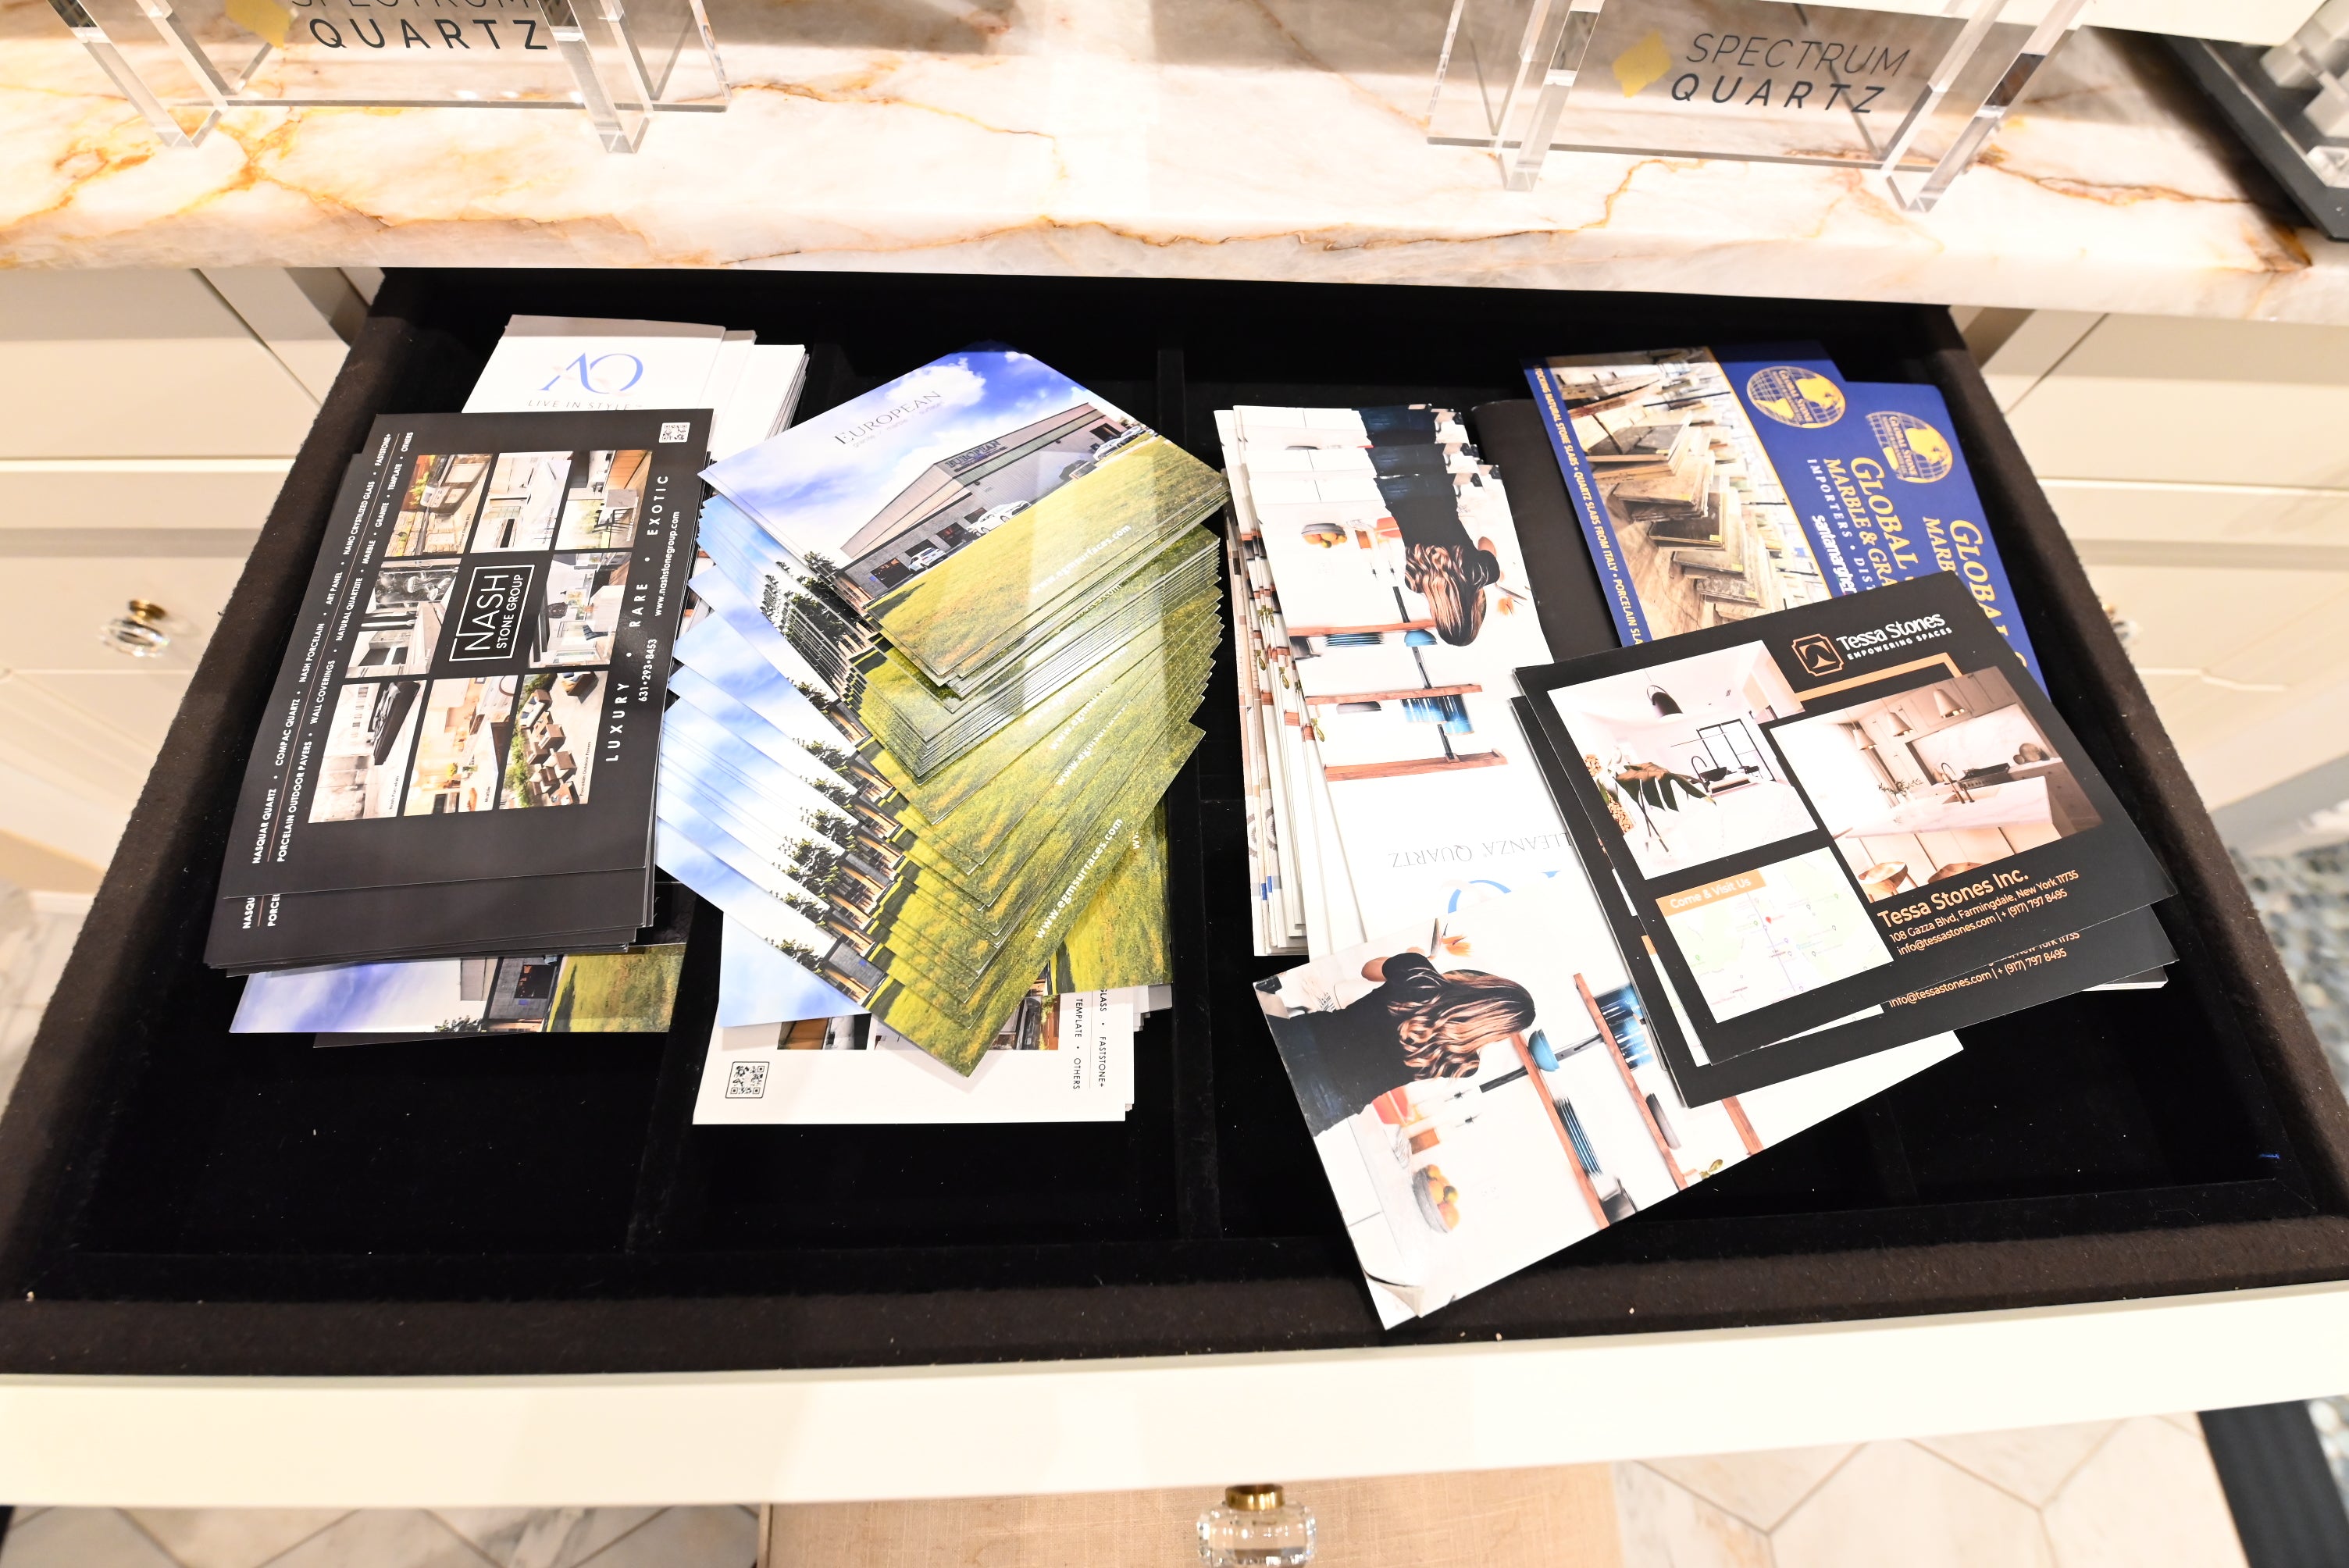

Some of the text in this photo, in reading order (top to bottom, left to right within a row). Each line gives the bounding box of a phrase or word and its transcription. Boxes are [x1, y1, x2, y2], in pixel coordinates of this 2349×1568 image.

[309, 18, 548, 50] QUARTZ
[1686, 33, 1910, 77] SPECTRUM
[1671, 73, 1886, 113] QUARTZ
[834, 390, 941, 444] EUROPEAN
[1545, 393, 1562, 422] NATURAL
[1556, 422, 1571, 444] STONE
[1564, 444, 1580, 467] SLABS
[1574, 471, 1592, 501] QUARTZ
[1585, 500, 1601, 526] SLABS
[1594, 526, 1610, 549] FROM
[1602, 549, 1619, 572] ITALY
[1613, 578, 1638, 626] PORCELAIN
[1807, 458, 1852, 538] IMPORTERS
[1823, 458, 1873, 529] MARBLE
[1859, 530, 1879, 546] &
[1850, 457, 1919, 570] GLOBAL
[654, 511, 680, 617] www.nashstonegroup.com
[1030, 524, 1132, 594] www.egmsurfaces.com
[1923, 516, 1959, 575] MARB
[456, 575, 509, 650] NASH
[496, 574, 524, 649] STONE GROUP
[605, 683, 629, 762] LUXURY
[629, 583, 648, 628] RARE
[647, 476, 668, 536] EXOTIC
[1835, 613, 1945, 651] Tessa Stones
[1846, 627, 1953, 661] EMPOWERING SPACES
[251, 821, 269, 864] NASQUAR
[262, 788, 277, 820] QUARTZ
[275, 729, 291, 766] COMPAC
[285, 698, 301, 728] QUARTZ
[299, 663, 311, 682] NASH
[305, 623, 325, 661] PORCELAIN
[326, 593, 334, 605] ART
[330, 572, 343, 593] PANEL
[343, 536, 355, 555] NANO
[363, 480, 375, 500] GLASS
[276, 432, 414, 862] PORCELAIN OUTDOOR PAVERS WALL COVERINGS NATURAL QUARTZITE MARBLE GRANITE TEMPLATE OTHERS
[1035, 818, 1124, 939] www.egmsurfaces.com
[1388, 844, 1473, 868] QUARTZ
[1670, 876, 1752, 909] Come & Visit Us
[1877, 868, 2029, 928] Tessa Stones Inc.
[1889, 869, 2080, 943] 108 Gazza Blvd, Farmingdale, New York 11735
[1896, 914, 1997, 956] info@tessastones.com
[2007, 903, 2029, 919] (917)
[2026, 896, 2044, 909] 797
[2044, 888, 2068, 902] 8495
[2004, 959, 2026, 975] (917)
[2025, 954, 2043, 967] 797
[2043, 947, 2067, 961] 8495
[1073, 998, 1083, 1090] TEMPLATE OTHERS
[1098, 1036, 1107, 1088] FASTSTONE+
